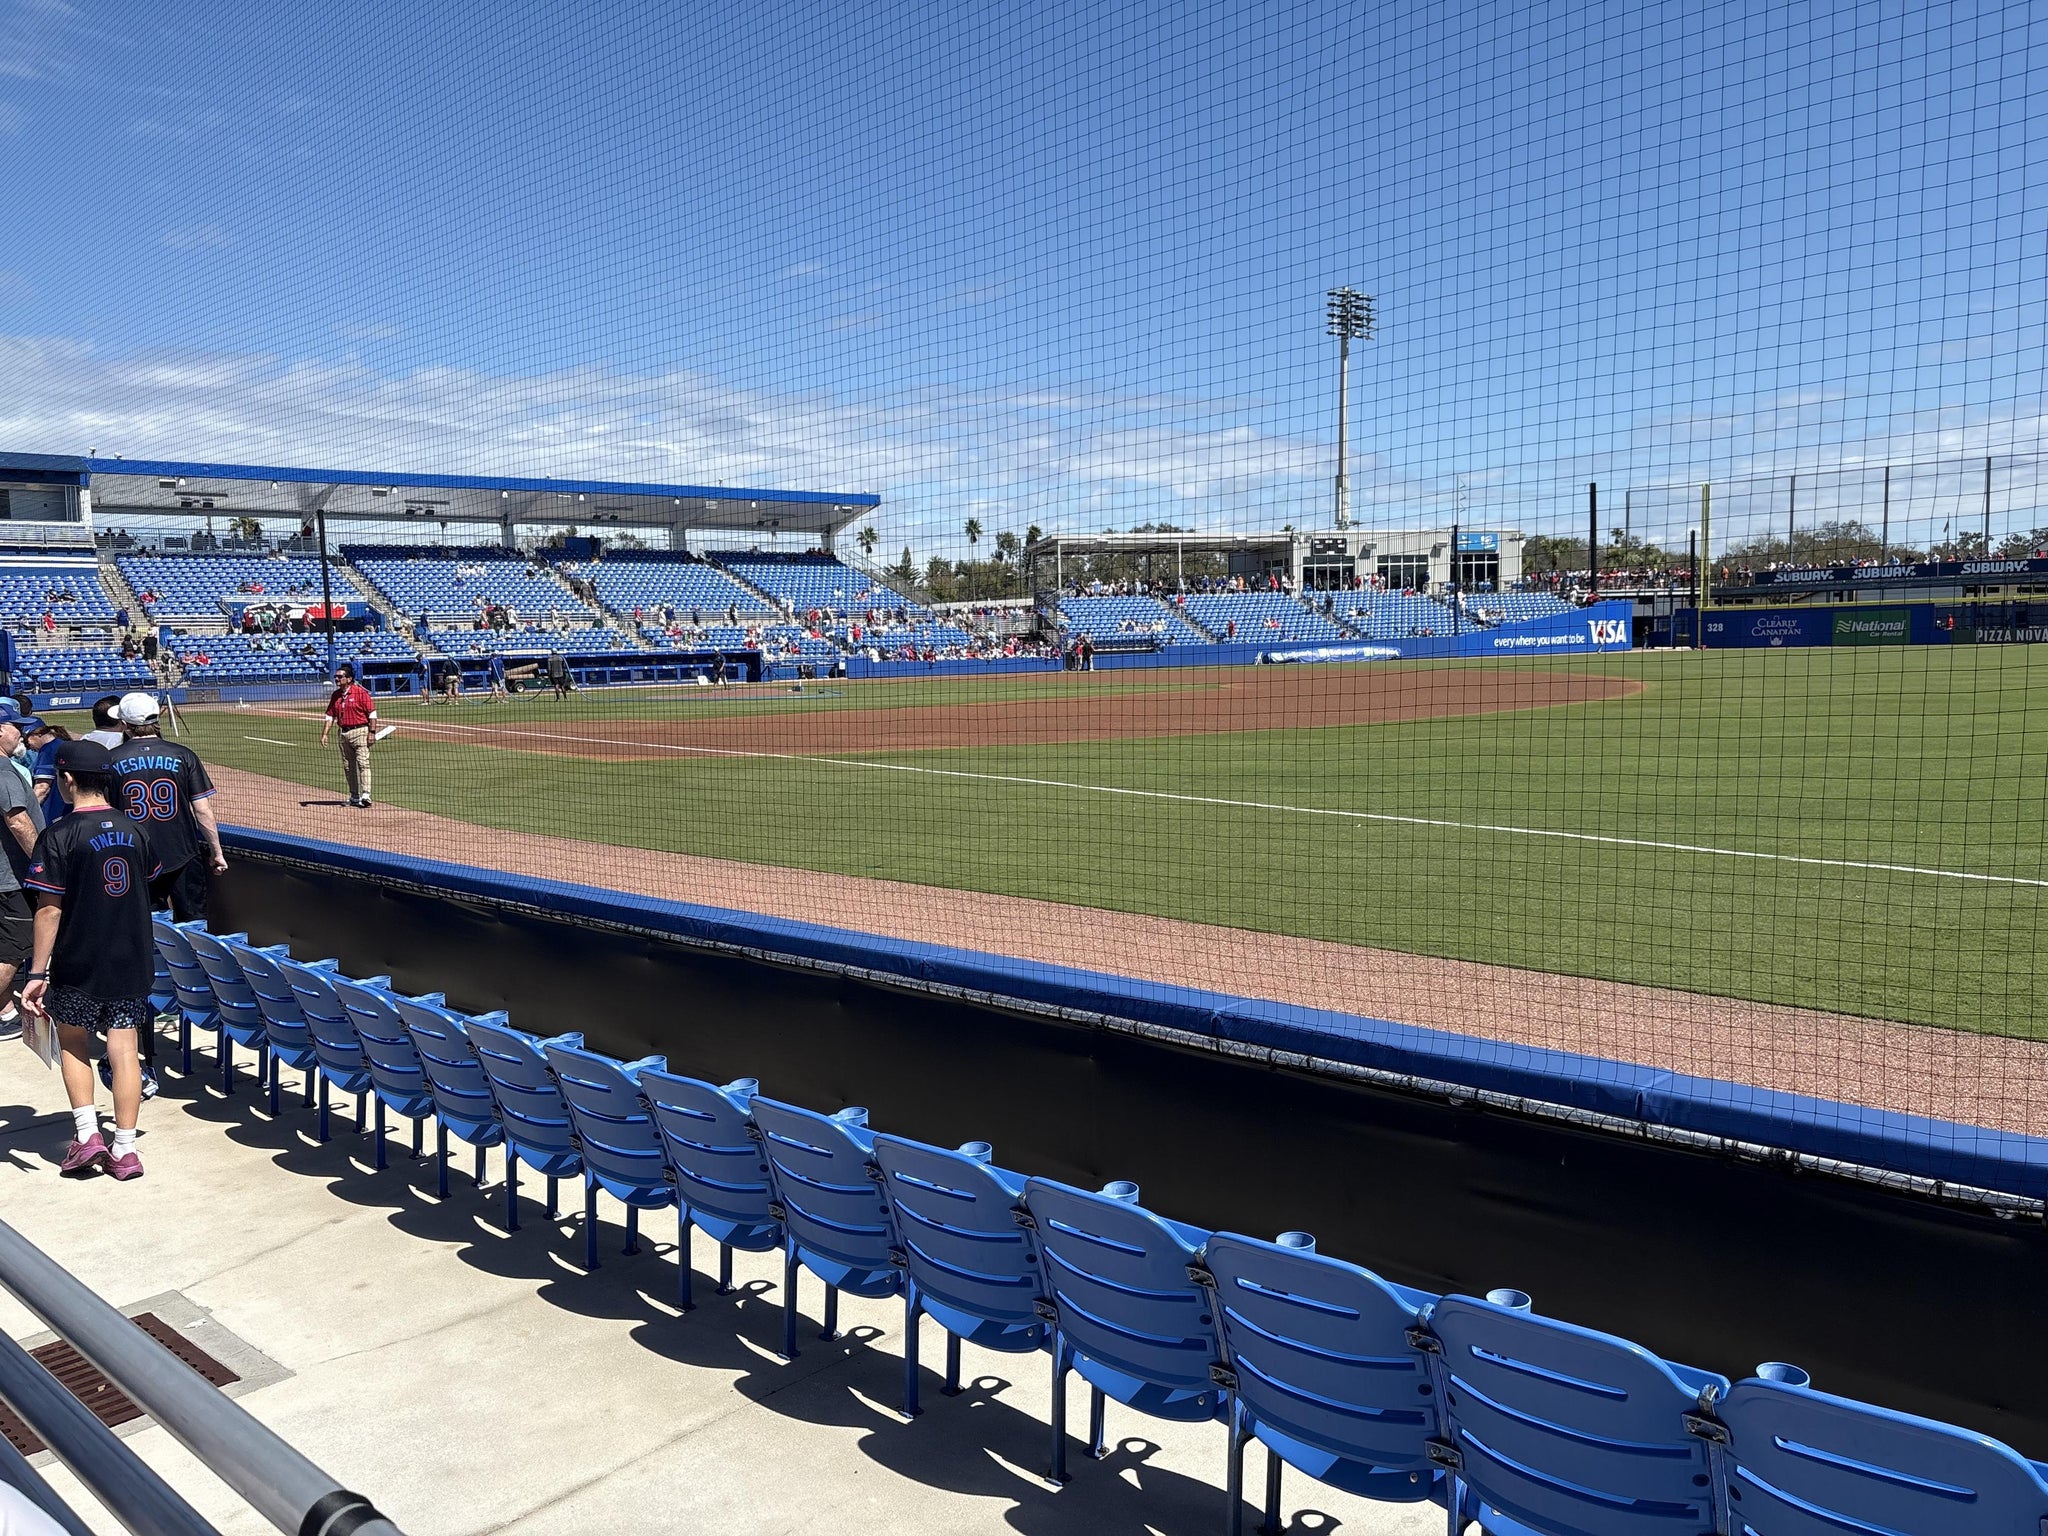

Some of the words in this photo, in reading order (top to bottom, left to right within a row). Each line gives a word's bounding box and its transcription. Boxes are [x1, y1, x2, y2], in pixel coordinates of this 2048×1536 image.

[1852, 566, 1917, 580] SUBWAY
[1960, 560, 2030, 575] SUBWAY
[1774, 570, 1835, 582] SUBWAY
[1707, 623, 1724, 632] 328
[1757, 618, 1797, 628] CLEARLY
[1851, 620, 1905, 632] National
[1587, 619, 1627, 644] VISA
[1751, 626, 1801, 637] CANADIAN
[1976, 629, 2011, 642] PIZZA
[2016, 628, 2048, 642] NOVA
[1537, 637, 1550, 647] you
[1551, 634, 1568, 645] want
[1568, 635, 1576, 644] to
[1576, 633, 1585, 644] be
[112, 755, 182, 776] YESAVAGE
[122, 778, 178, 823] 39
[103, 856, 130, 897] 9
